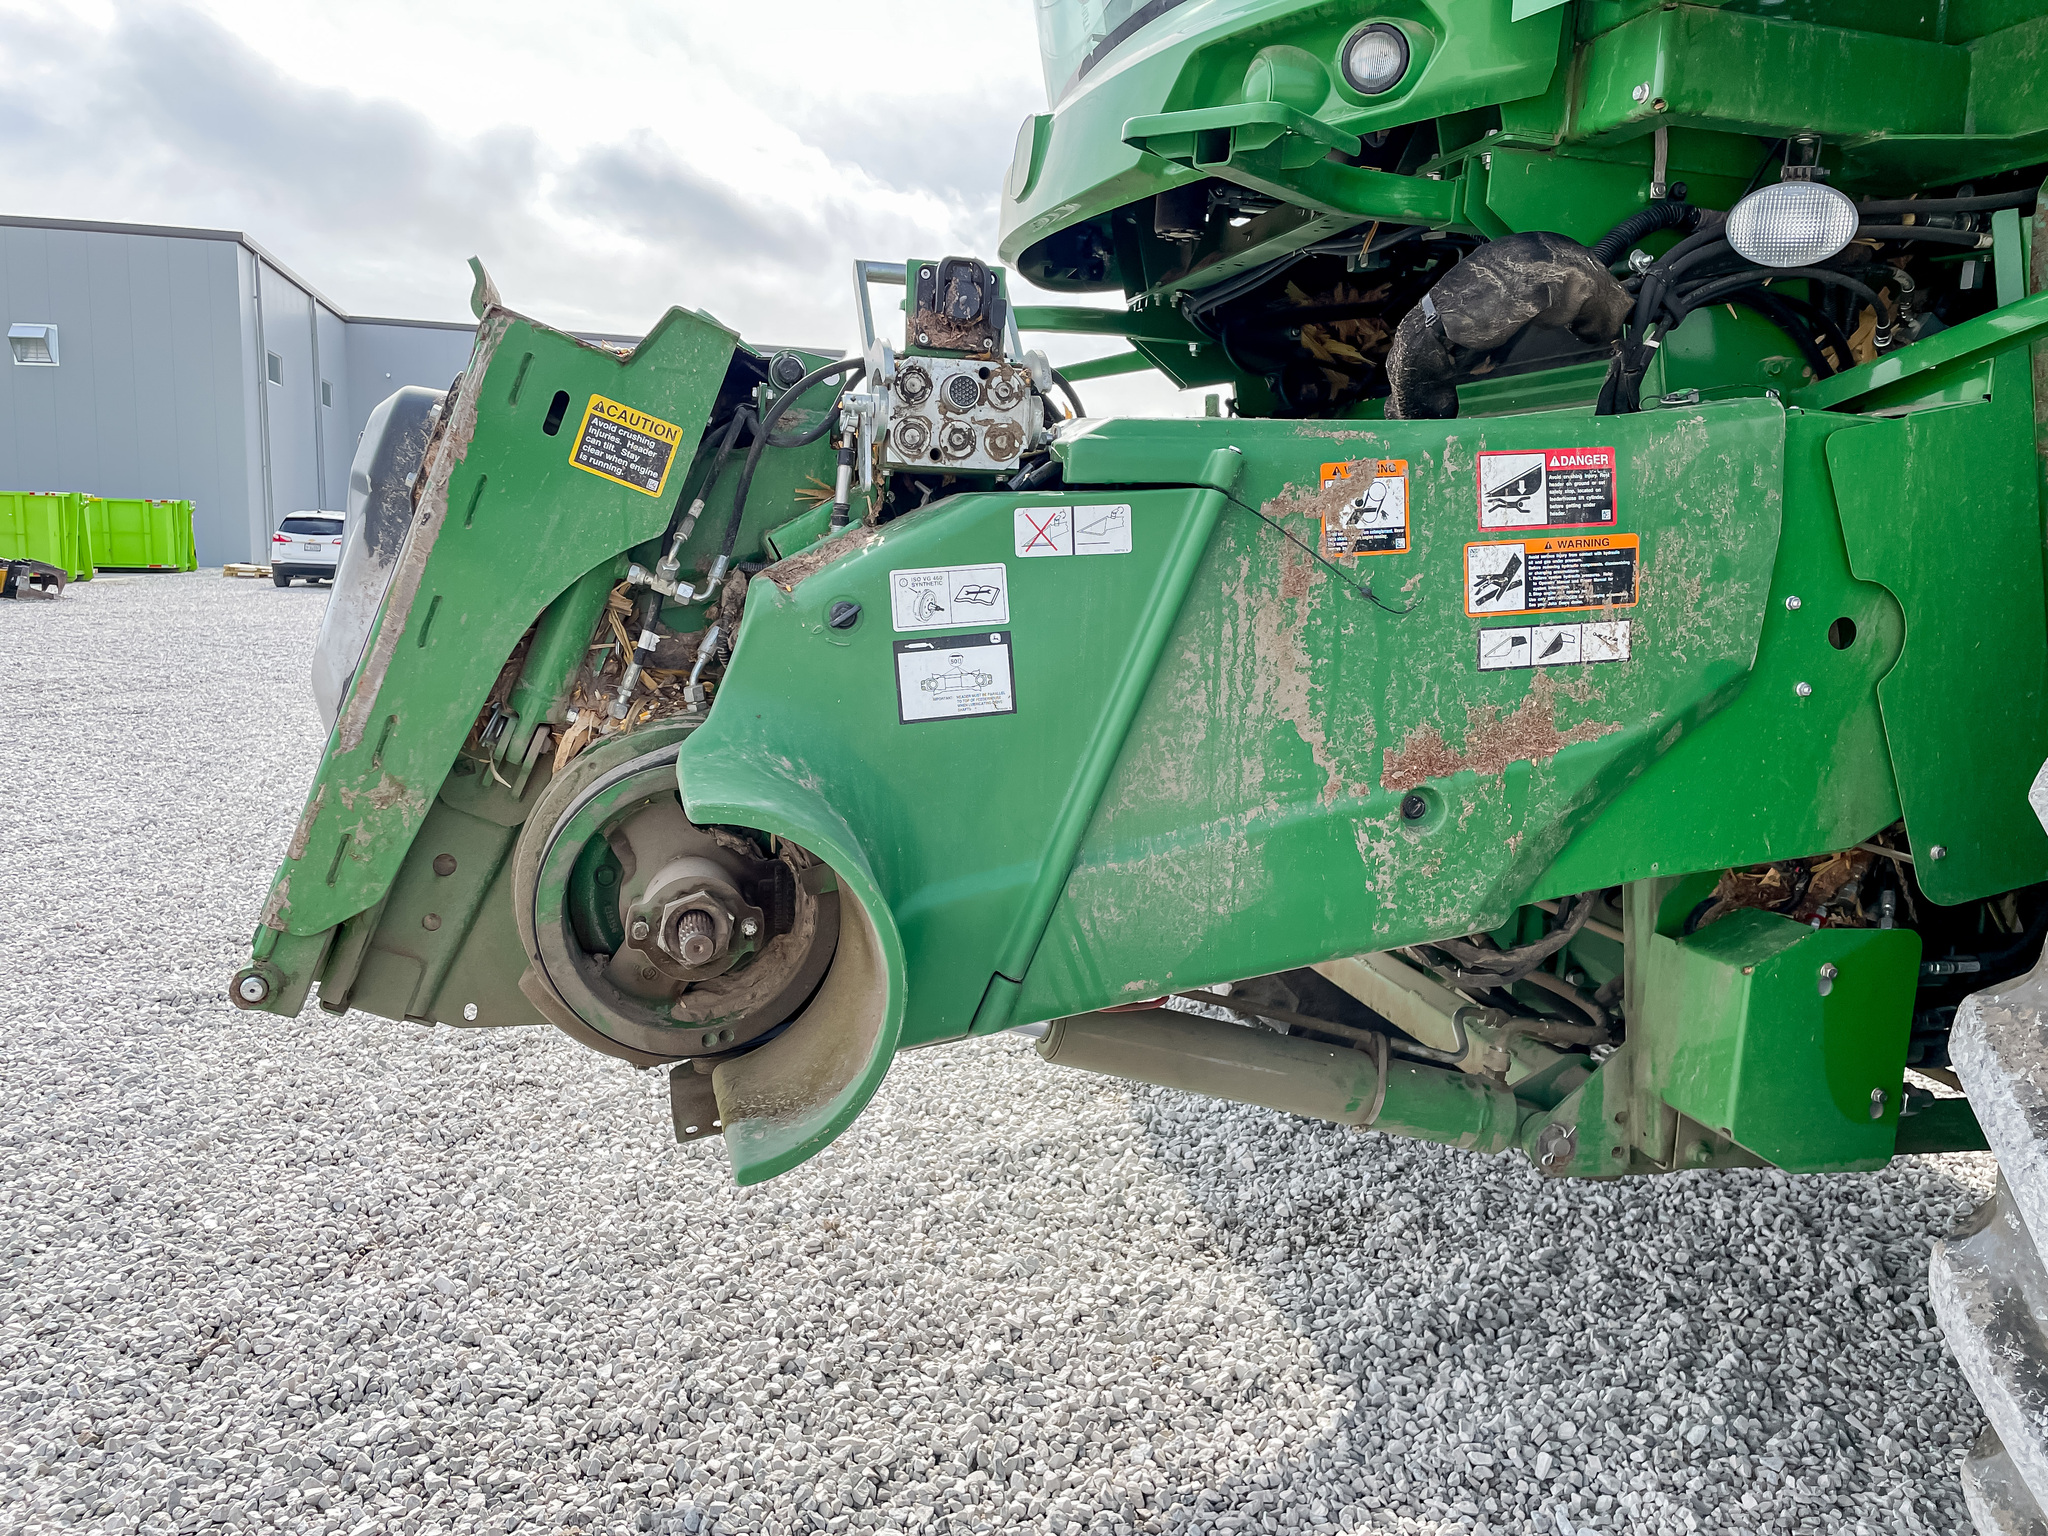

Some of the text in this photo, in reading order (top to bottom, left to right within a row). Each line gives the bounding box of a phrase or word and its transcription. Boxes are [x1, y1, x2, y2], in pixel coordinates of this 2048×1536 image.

[591, 417, 656, 448] Avoid crushing
[606, 405, 677, 441] CAUTION
[582, 444, 658, 478] clear when engine
[585, 437, 640, 462] can tilt. Stay
[627, 441, 657, 458] Header
[1560, 455, 1608, 466] DANGER
[579, 452, 624, 476] is running.
[1557, 538, 1610, 549] WARNING
